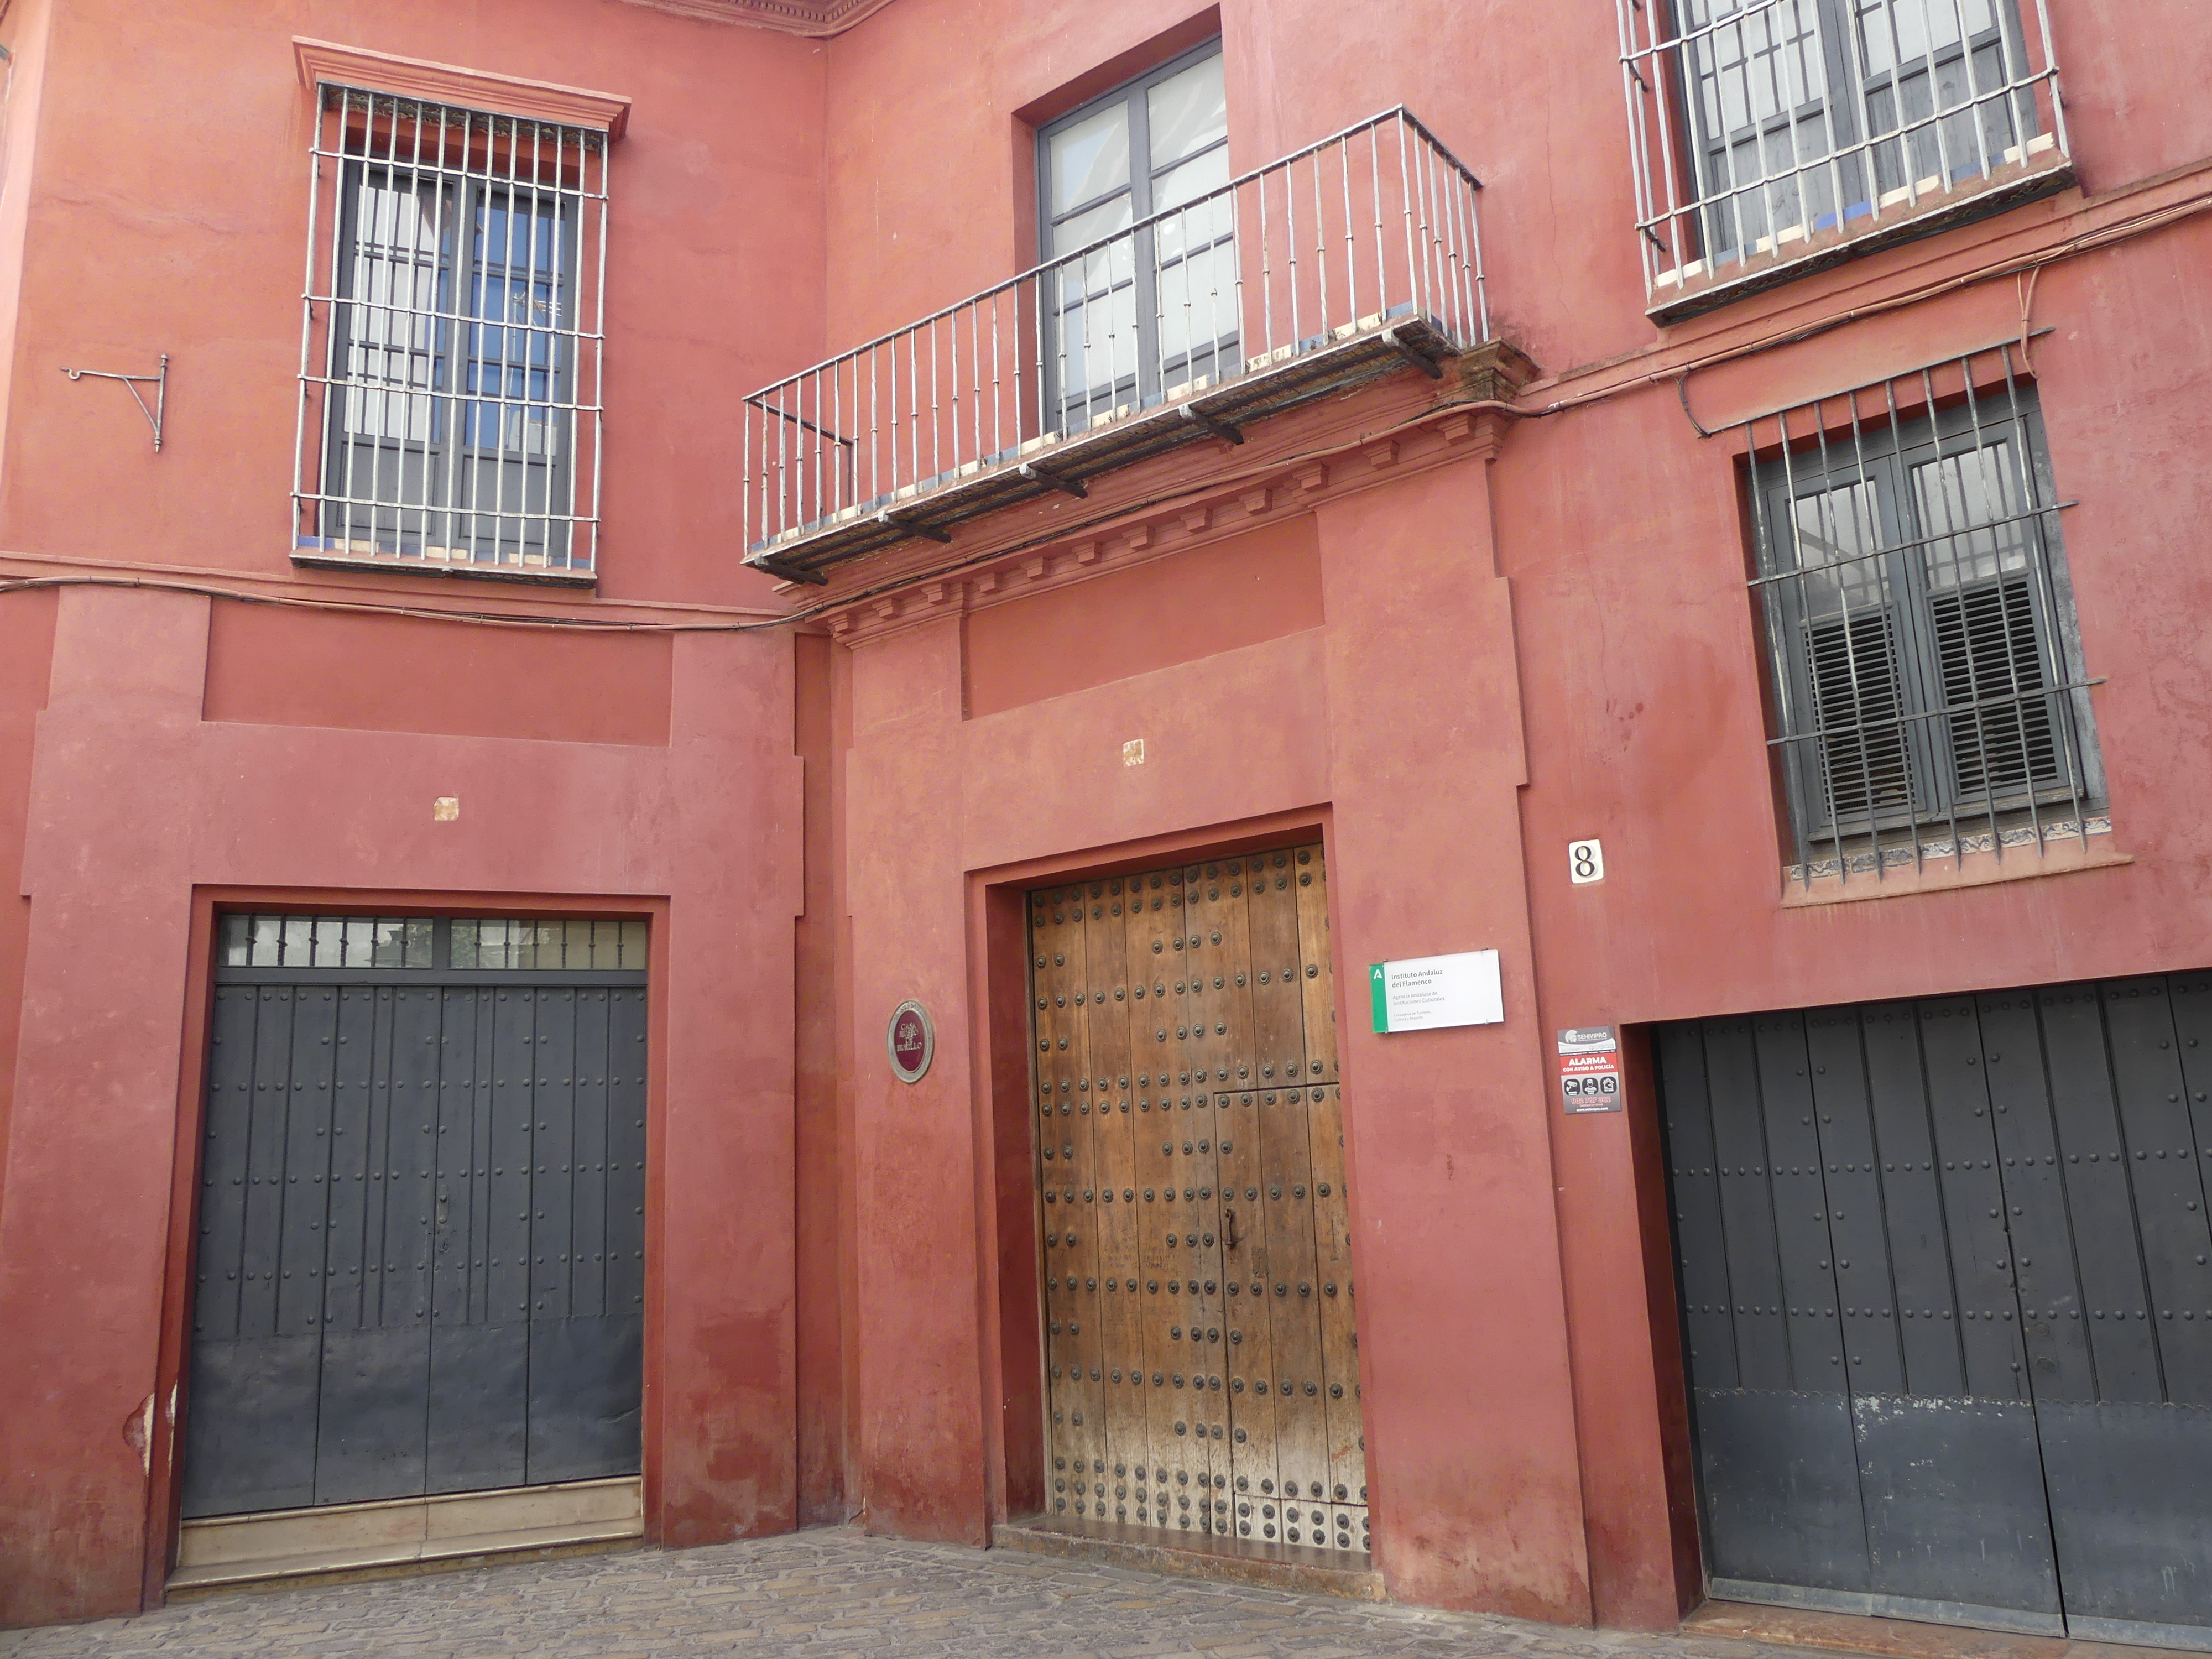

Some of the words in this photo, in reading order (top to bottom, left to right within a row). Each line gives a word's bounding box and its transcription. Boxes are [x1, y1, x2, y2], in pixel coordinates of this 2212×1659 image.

[1574, 846, 1595, 877] 8
[1402, 979, 1432, 987] Flamenco
[1568, 1056, 1607, 1066] ALARMA
